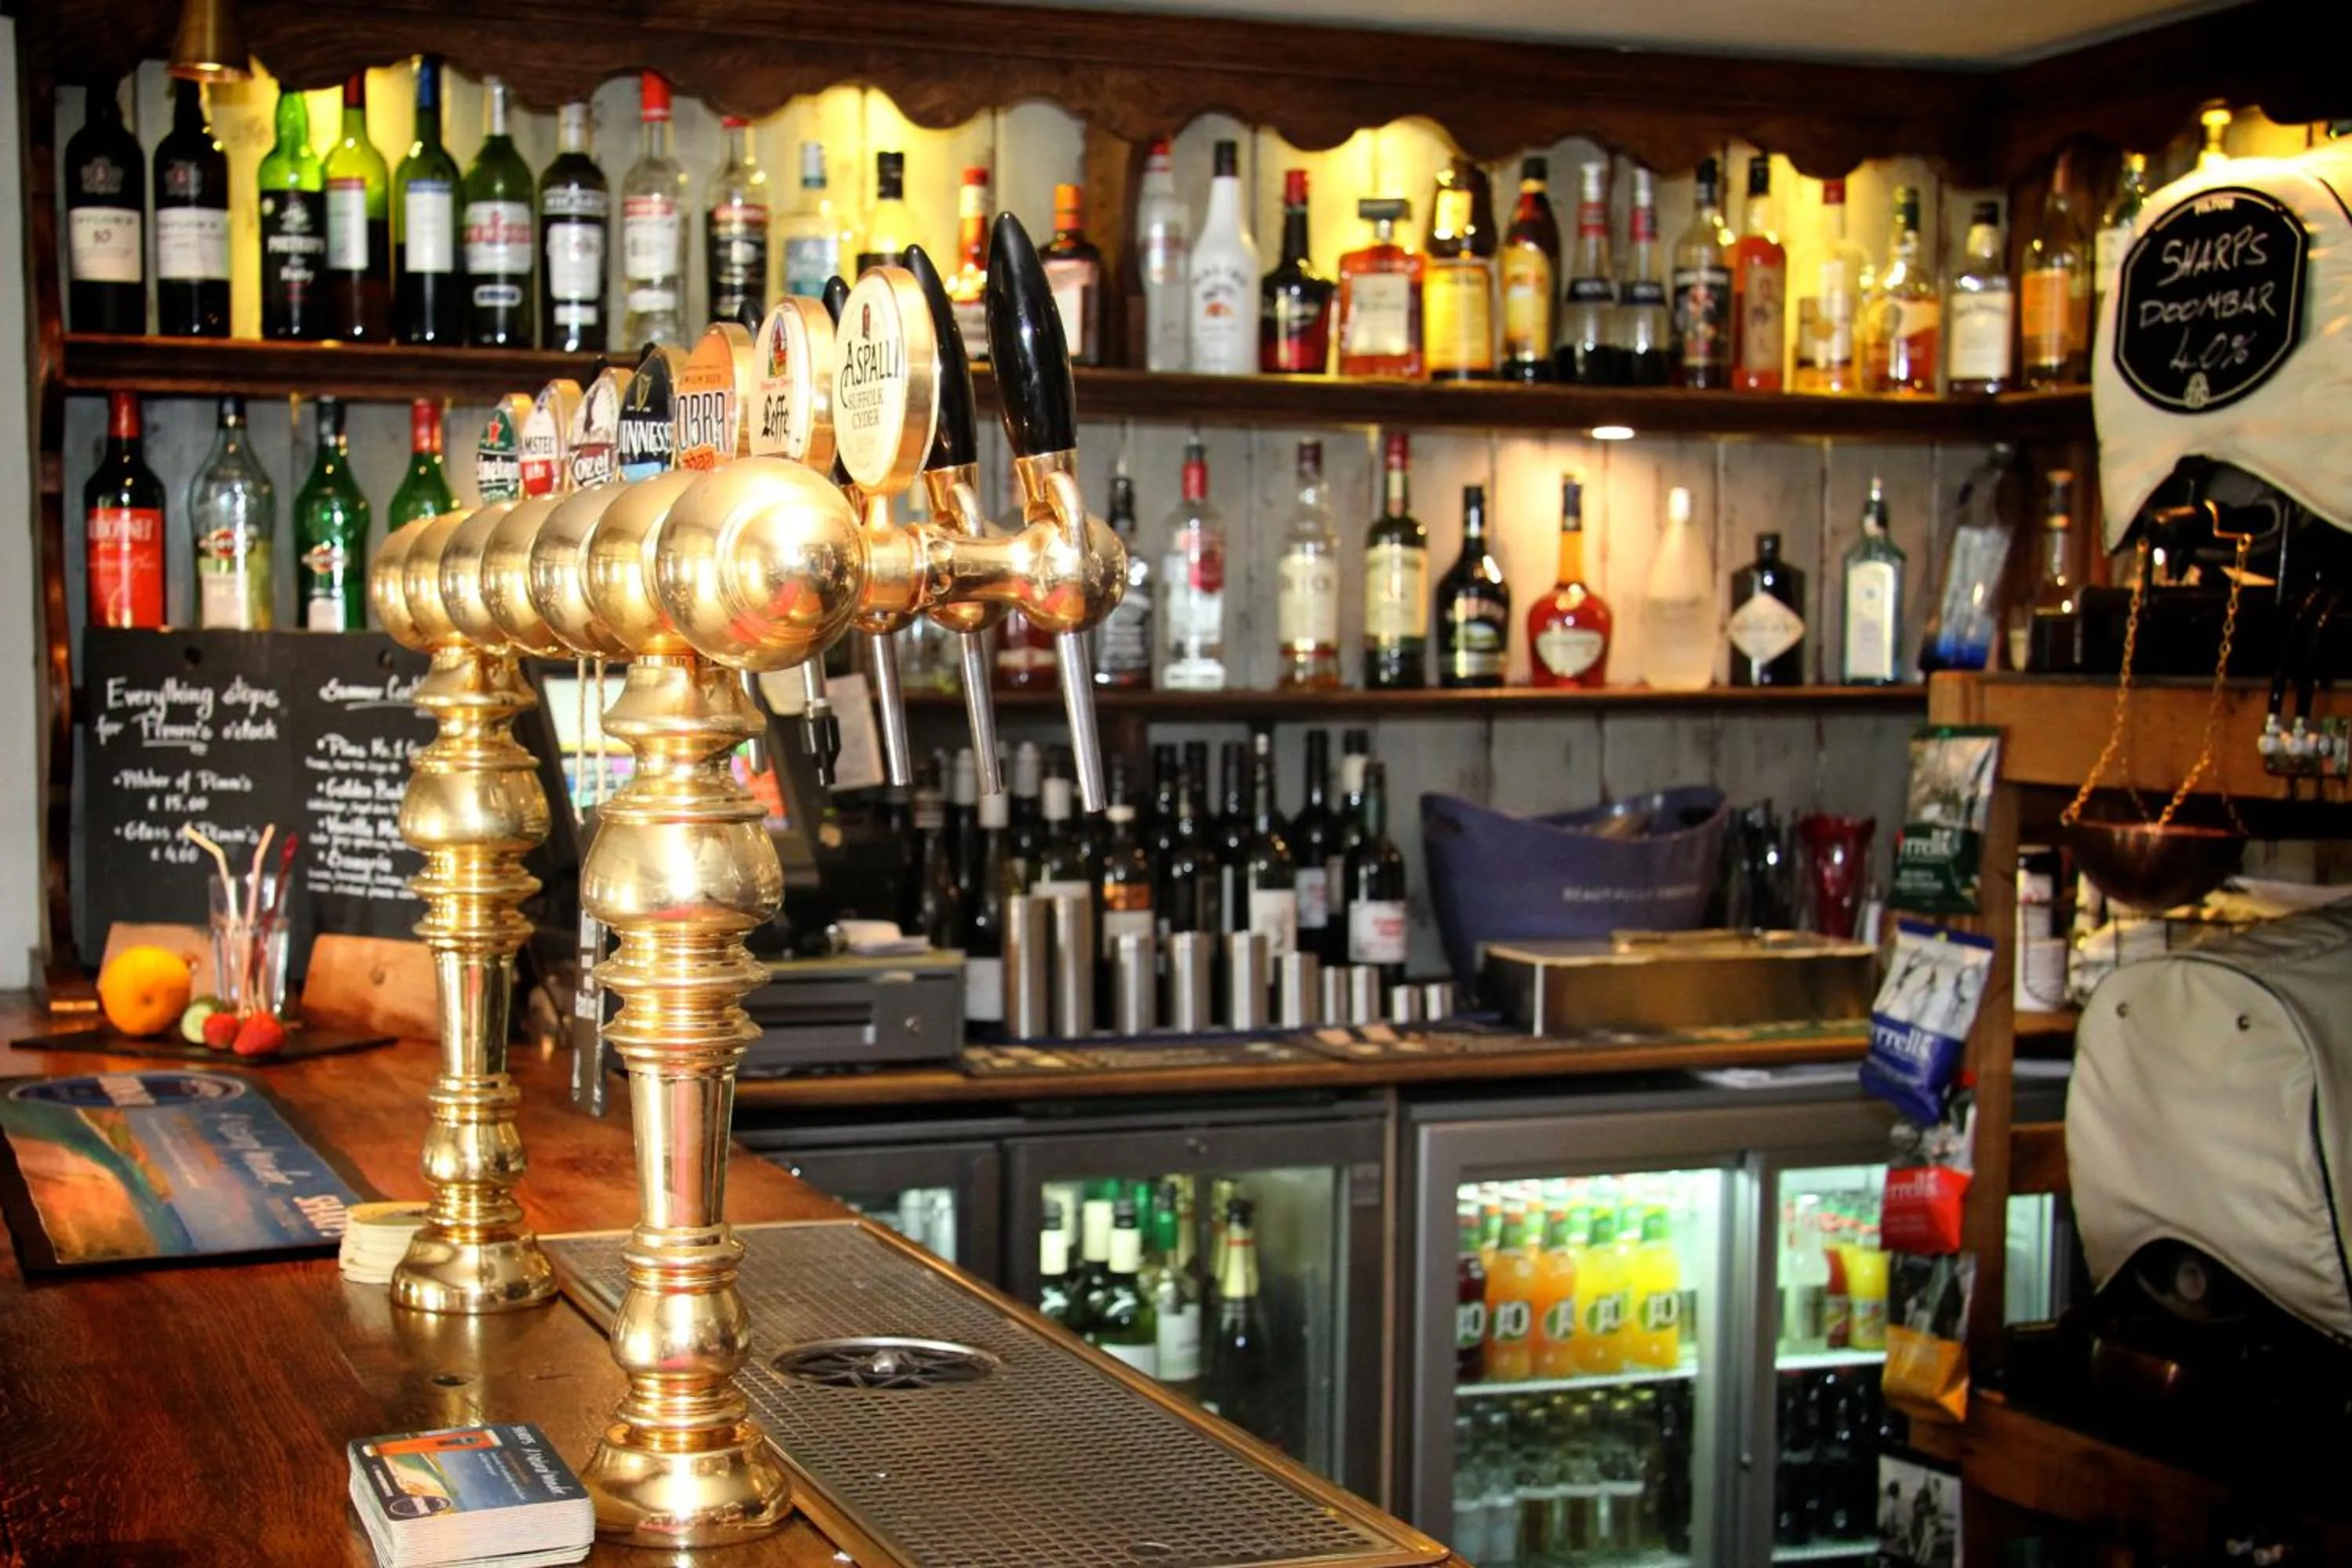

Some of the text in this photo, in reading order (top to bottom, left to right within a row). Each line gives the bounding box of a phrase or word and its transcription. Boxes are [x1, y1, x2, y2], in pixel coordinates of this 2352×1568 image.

[2157, 224, 2270, 287] SHARPS
[677, 392, 727, 452] OBRA
[851, 408, 880, 430] CYDER
[107, 676, 214, 720] Everything
